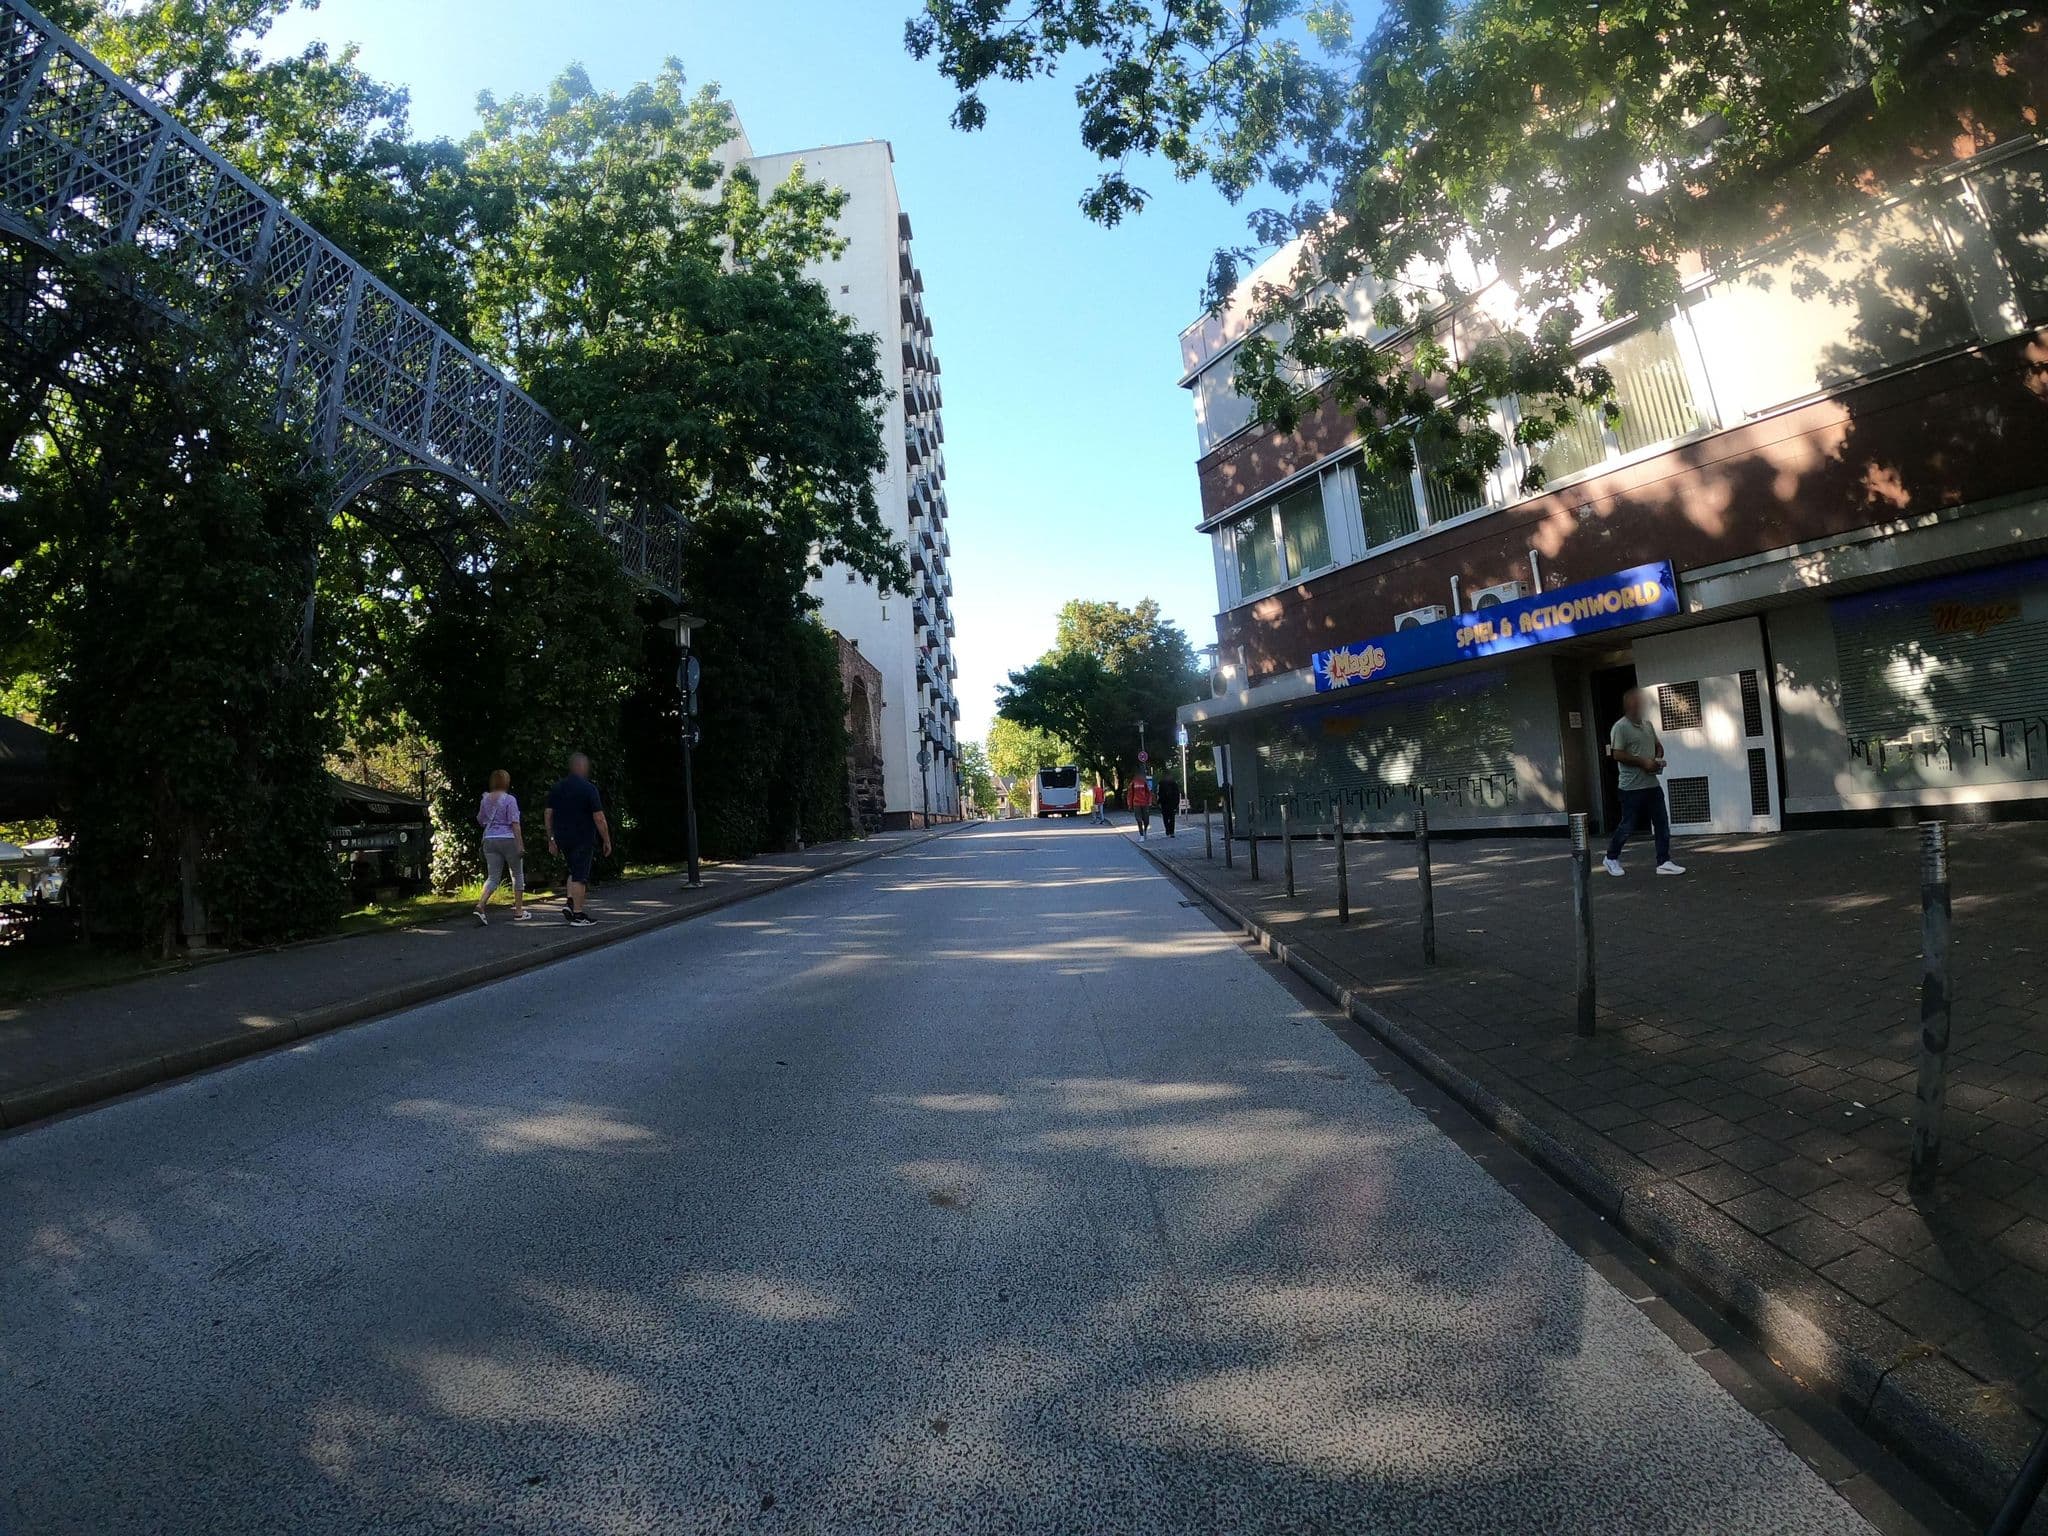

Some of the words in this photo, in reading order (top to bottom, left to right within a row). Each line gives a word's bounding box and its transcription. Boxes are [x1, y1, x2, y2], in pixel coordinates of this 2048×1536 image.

[1456, 620, 1498, 648] SPIEL
[1500, 617, 1512, 637] &
[1519, 581, 1661, 633] ACTIONWORLD
[1333, 645, 1386, 678] Magic
